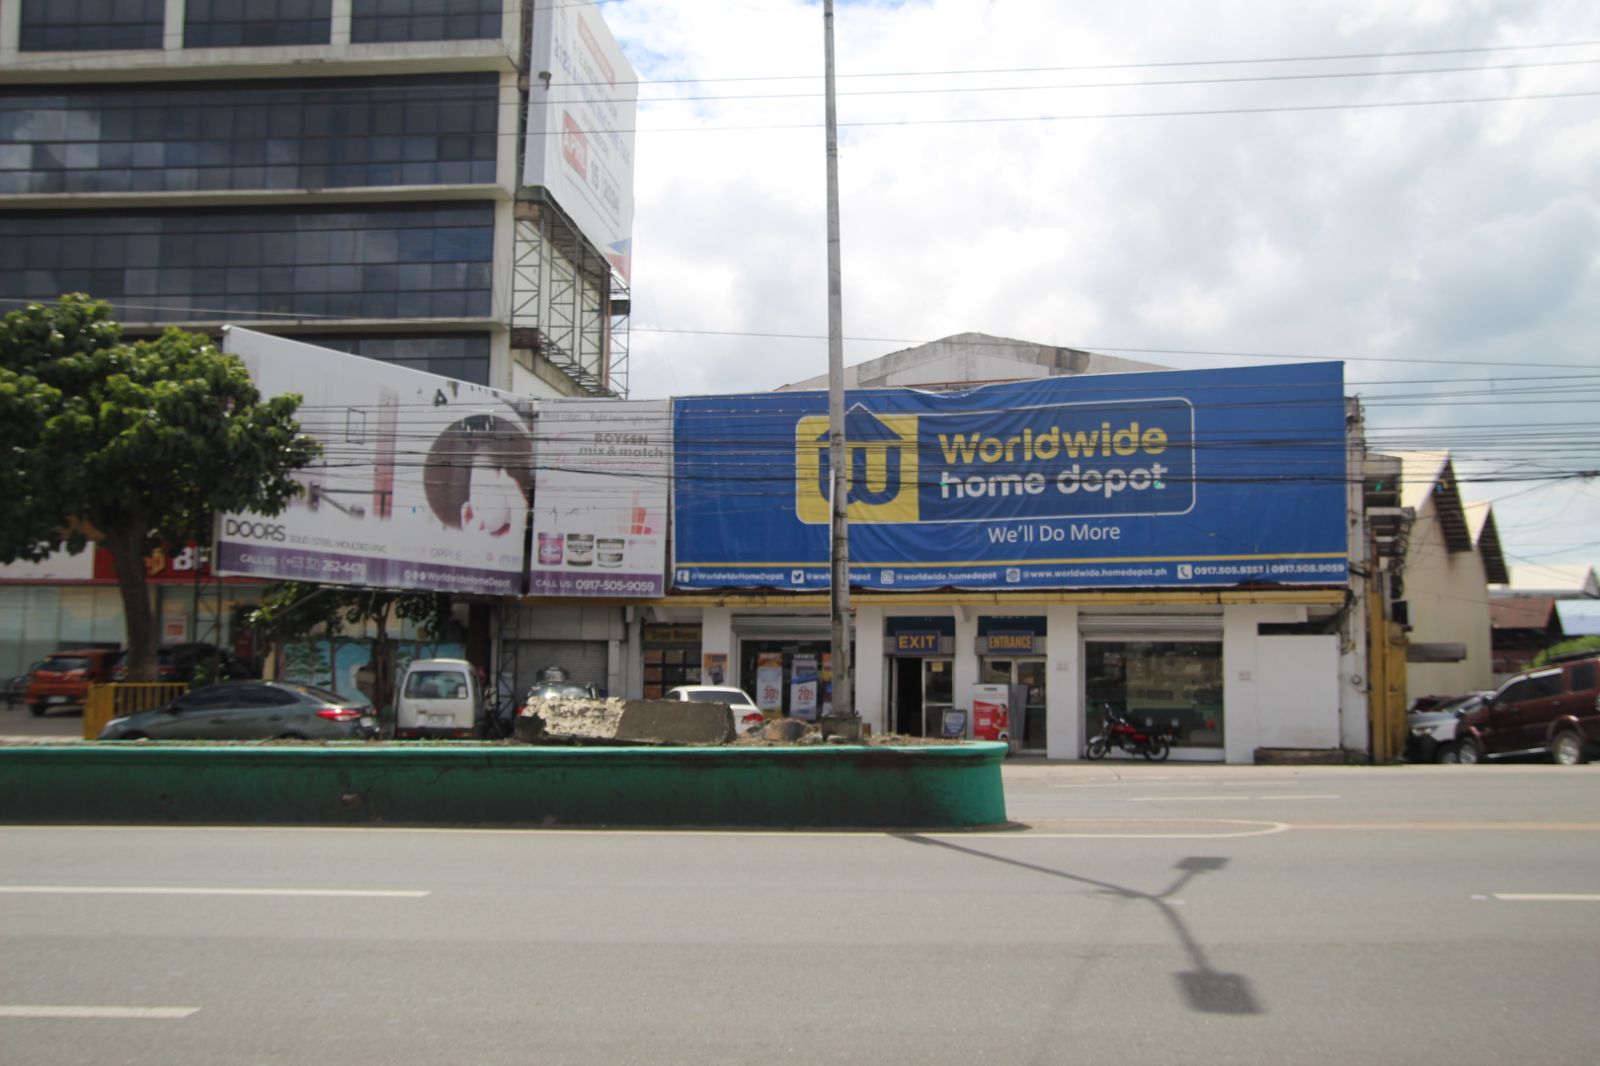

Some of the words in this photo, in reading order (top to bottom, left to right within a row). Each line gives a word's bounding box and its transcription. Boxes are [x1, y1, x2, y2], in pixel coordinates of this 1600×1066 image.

[594, 433, 648, 445] BOYSEN
[938, 422, 1168, 464] Worldwide
[940, 472, 1046, 499] home
[1057, 462, 1168, 498] depot
[226, 518, 286, 542] DOORS
[1040, 526, 1065, 542] Do
[1071, 524, 1121, 540] More
[535, 579, 558, 588] CALL
[575, 579, 655, 591] 0917-505-9059
[898, 635, 936, 649] EXIT
[989, 635, 1032, 649] ENTRANCE
